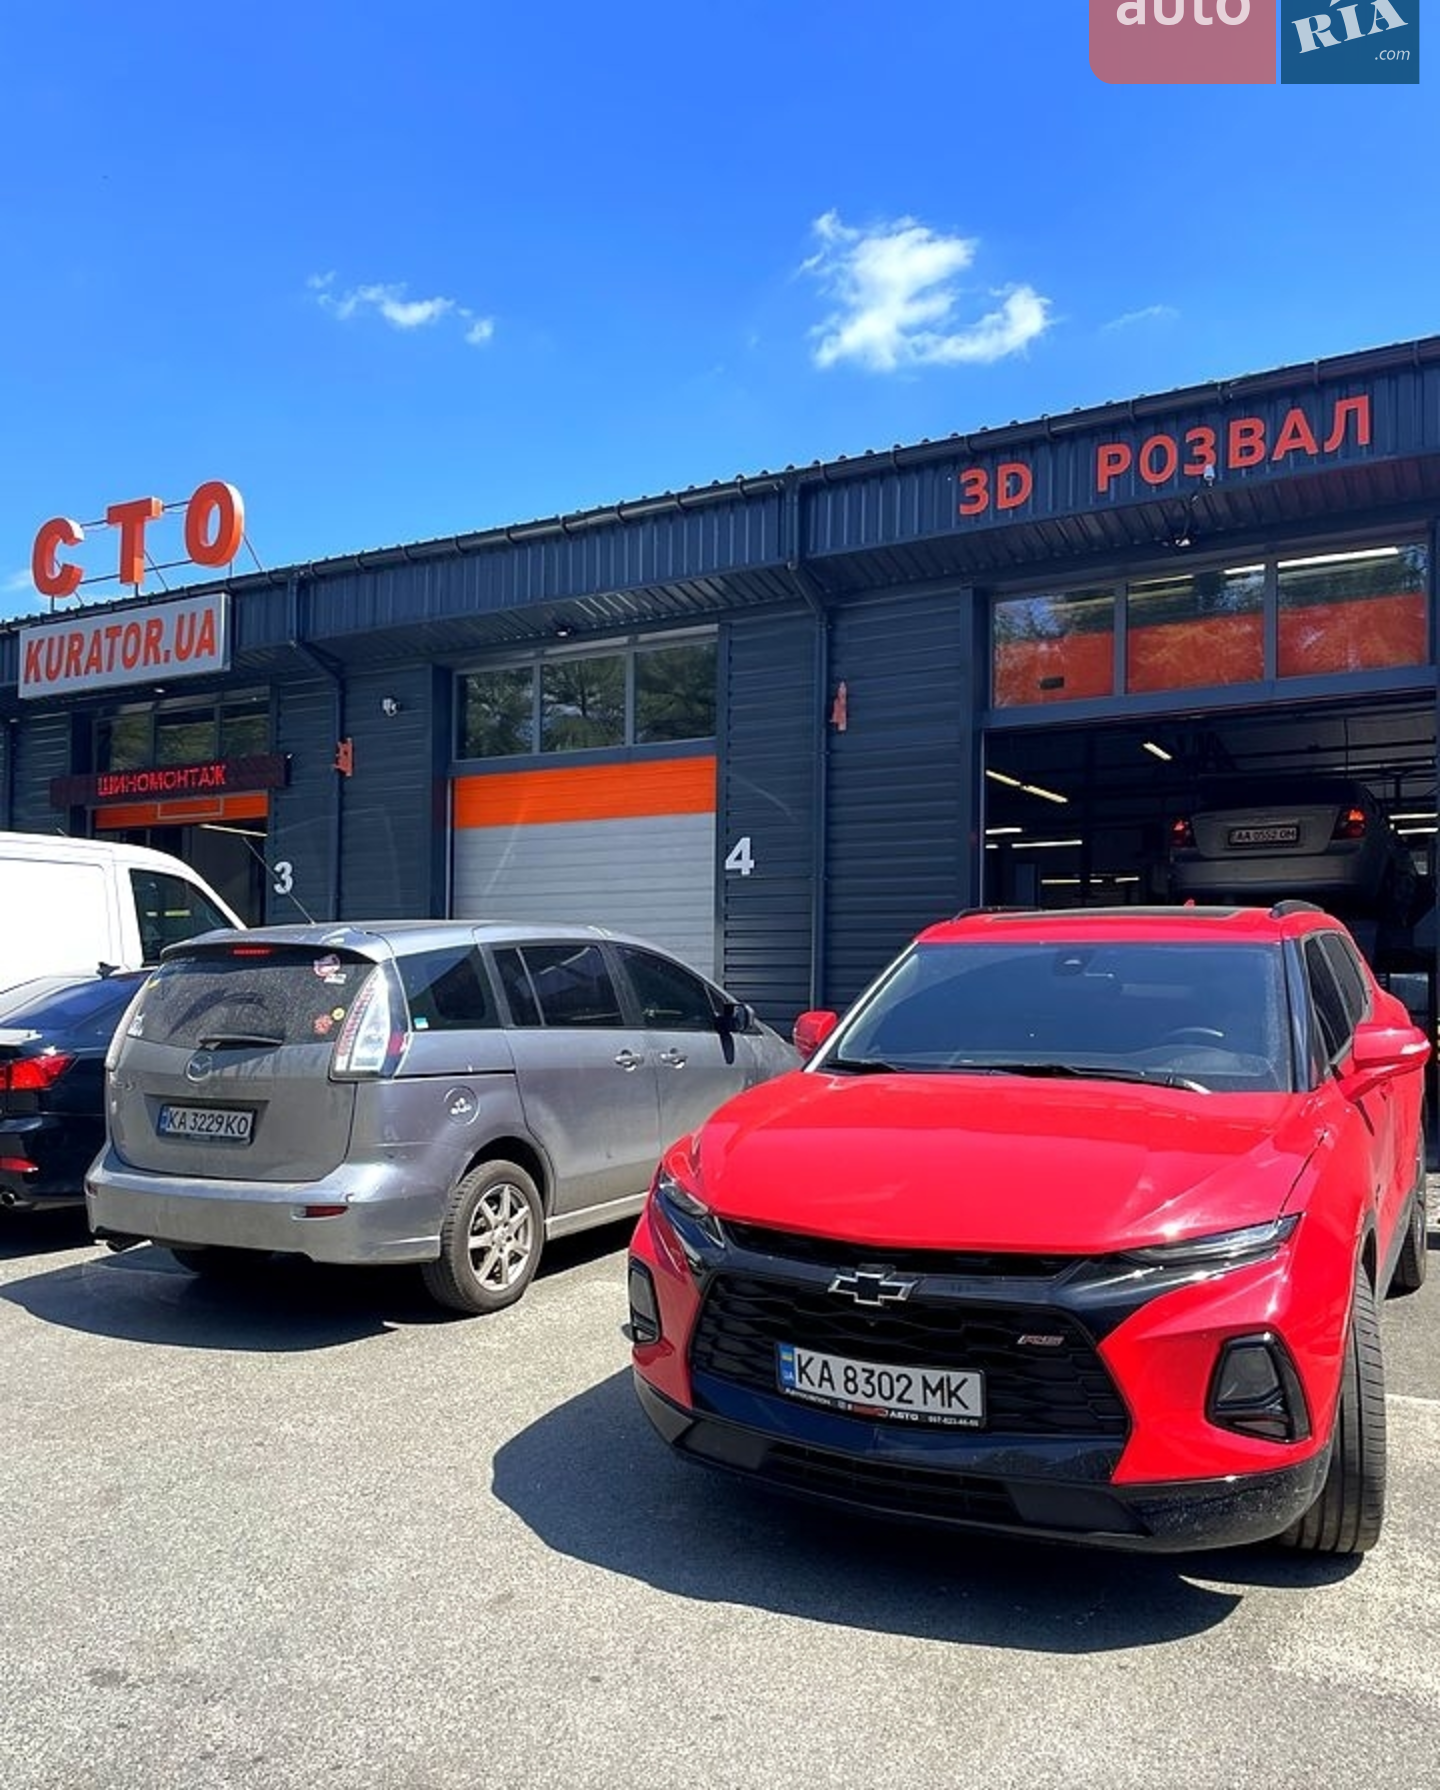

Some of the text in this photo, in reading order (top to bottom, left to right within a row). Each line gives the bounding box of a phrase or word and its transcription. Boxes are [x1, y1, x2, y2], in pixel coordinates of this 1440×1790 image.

[959, 395, 1371, 516] 3D РОЗВАЛ
[32, 480, 244, 597] СТО
[24, 608, 216, 684] KURATOR.UA
[97, 765, 227, 797] ШИНОМОНТАЖ
[273, 861, 294, 894] 3
[725, 837, 755, 875] 4
[797, 1353, 835, 1392] KA
[843, 1365, 914, 1405] 8302
[921, 1375, 971, 1411] MK
